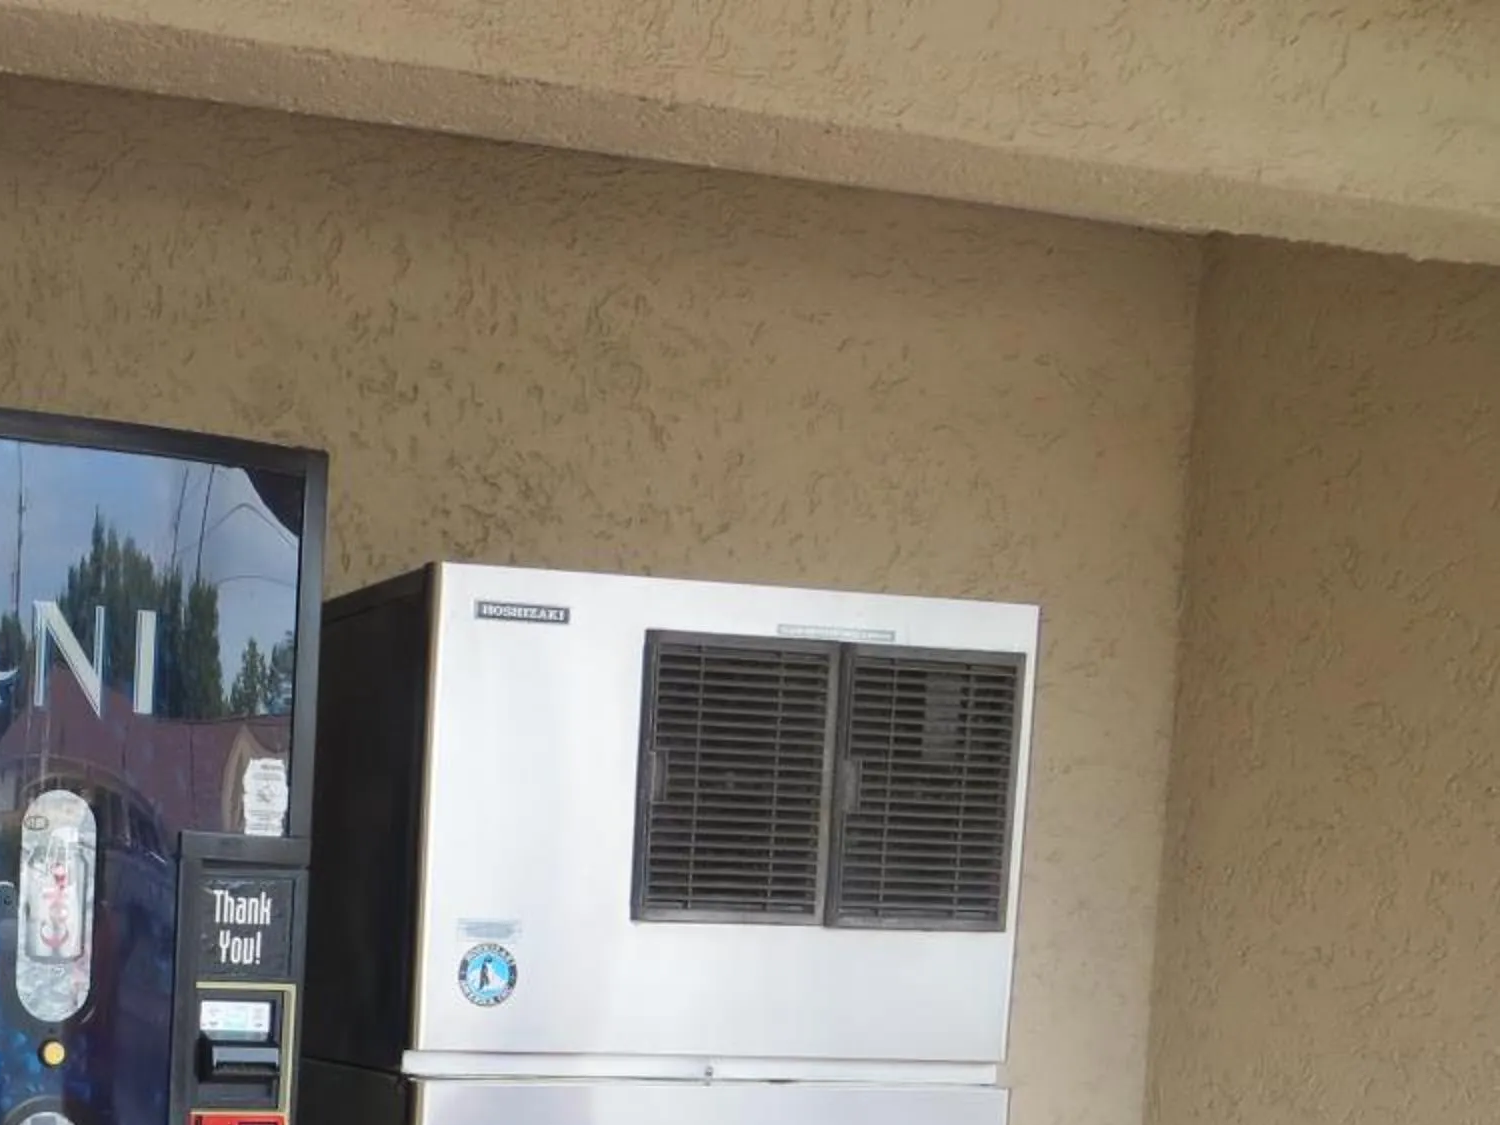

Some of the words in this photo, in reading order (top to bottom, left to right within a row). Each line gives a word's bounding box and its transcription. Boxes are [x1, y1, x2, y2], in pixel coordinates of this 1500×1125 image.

[481, 603, 566, 622] HOSHIZAKI
[213, 889, 272, 926] Thank
[219, 929, 262, 965] You!
